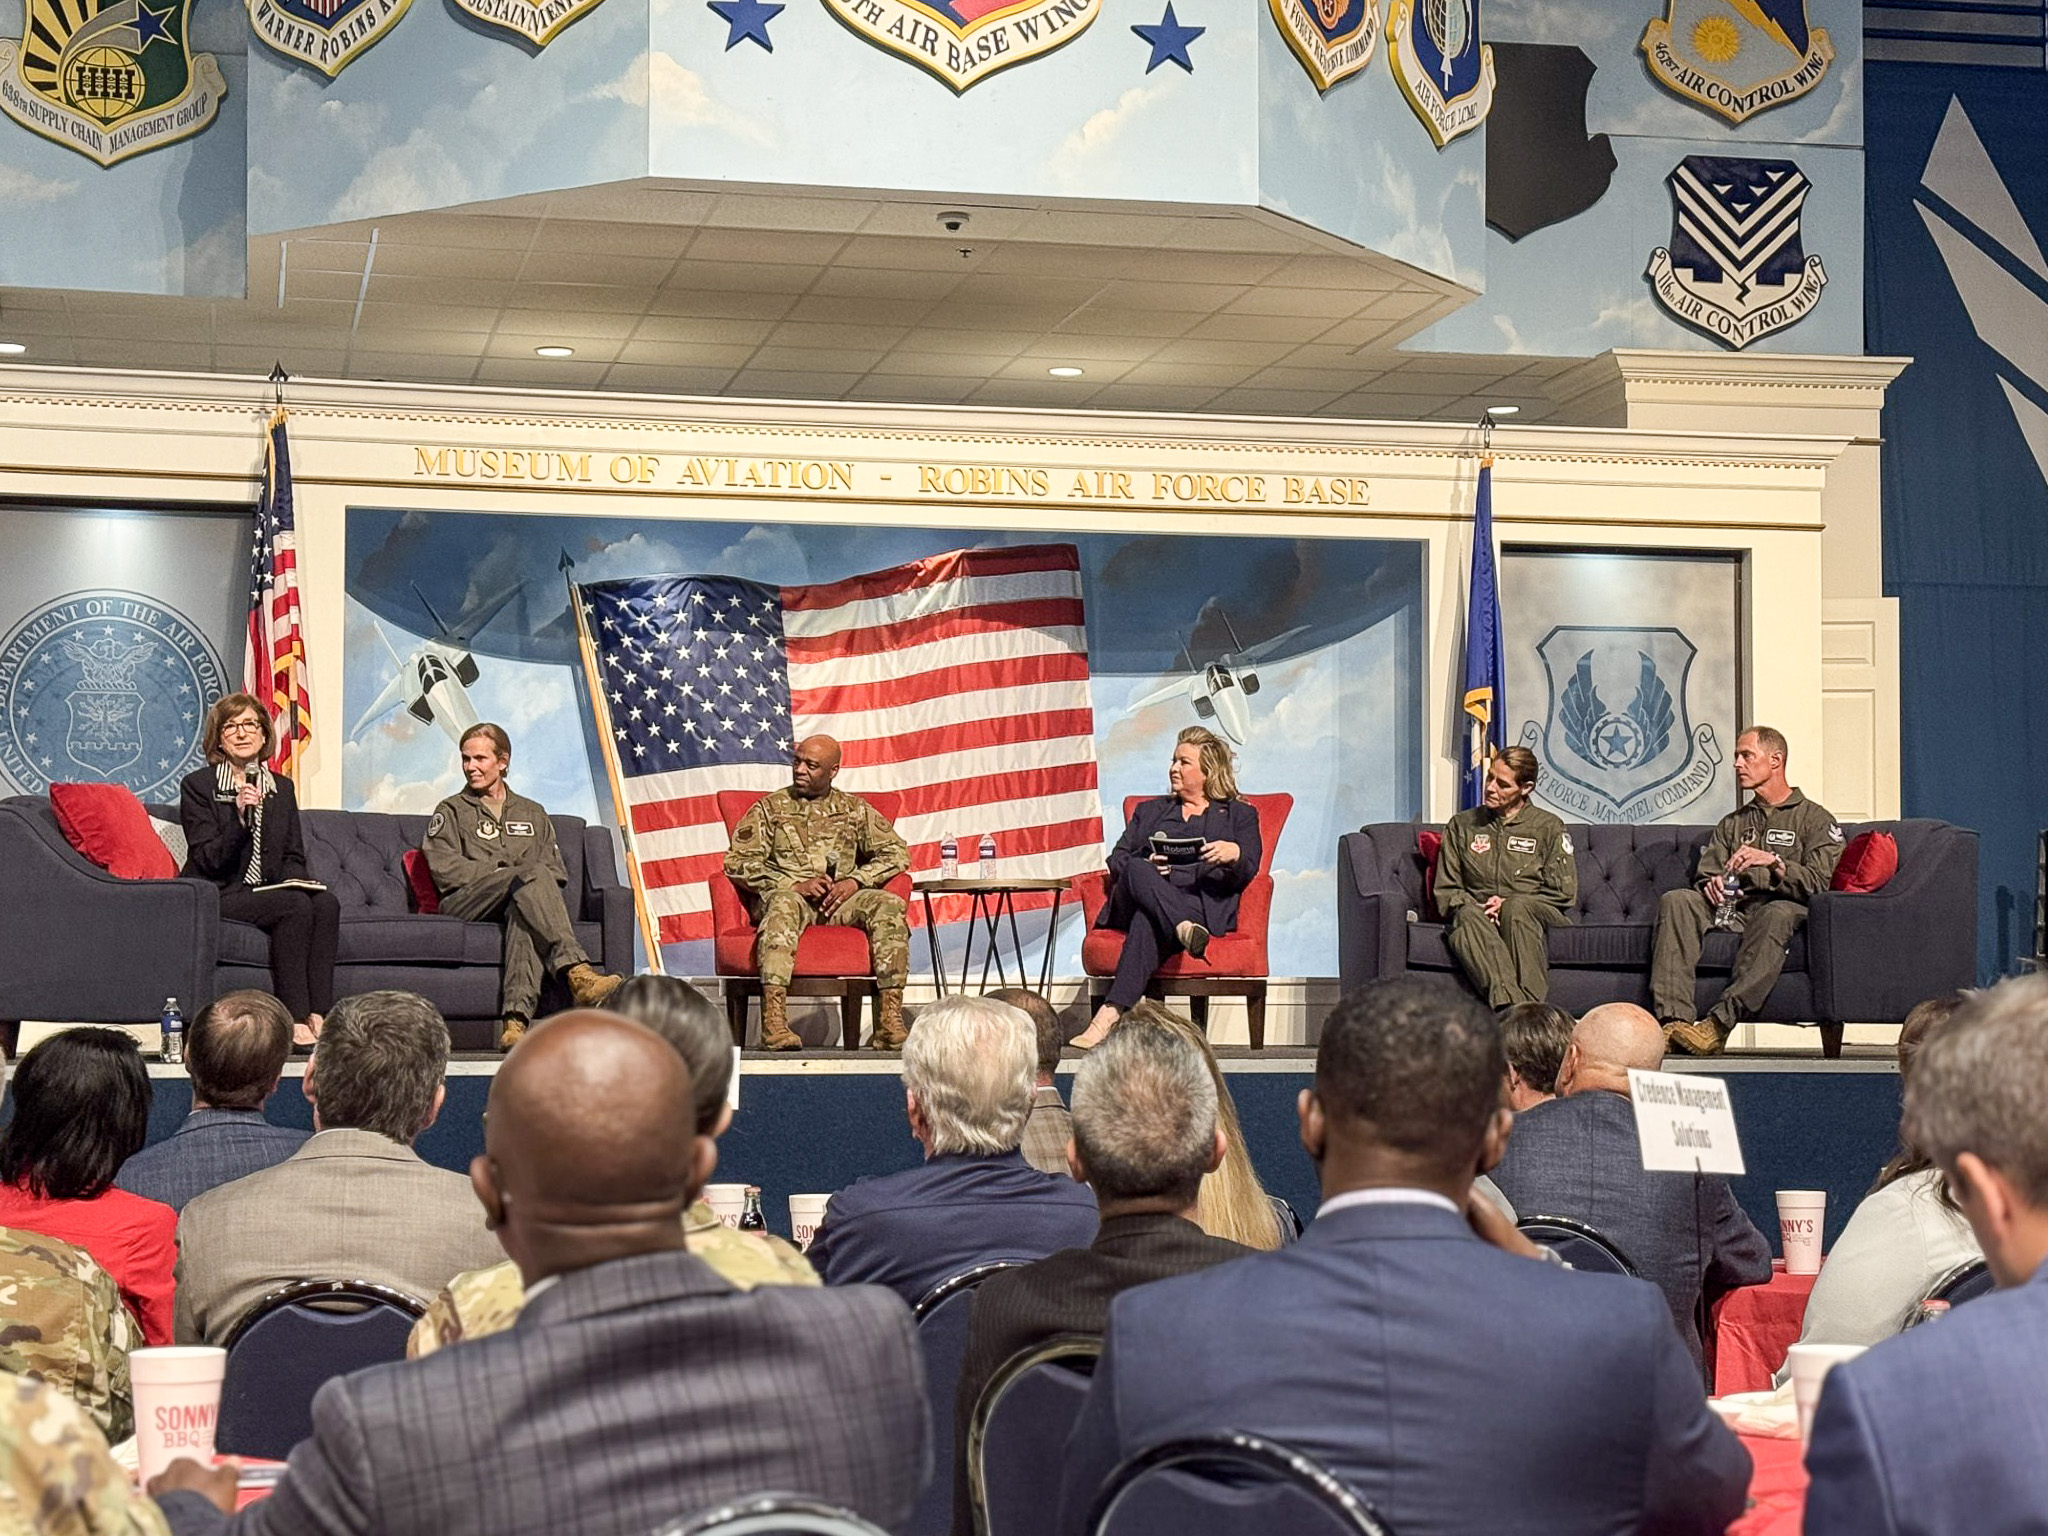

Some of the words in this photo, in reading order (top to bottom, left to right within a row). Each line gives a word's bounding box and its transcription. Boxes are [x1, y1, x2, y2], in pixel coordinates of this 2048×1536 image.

[257, 1, 314, 55] WARNER
[320, 7, 376, 64] ROBINS
[887, 14, 939, 56] AIR
[946, 26, 1010, 74] BASE
[1675, 67, 1706, 94] AIR
[1706, 79, 1795, 113] CONTROL
[1793, 51, 1824, 87] WING
[28, 101, 69, 133] SUPPLY
[70, 122, 103, 153] CHAIN
[109, 113, 175, 154] MANAGEMENT
[176, 92, 208, 127] GROUP
[1674, 294, 1704, 320] AIR
[1706, 304, 1793, 342] CONTROL
[1790, 274, 1819, 311] WING
[413, 446, 593, 483] MUSEUM
[609, 454, 661, 484] OF
[677, 457, 855, 491] AVIATION
[918, 464, 1050, 497] ROBINS
[1067, 470, 1135, 500] AIR
[1152, 473, 1267, 503] FORCE
[1283, 477, 1370, 506] BASE
[86, 600, 113, 616] OF
[119, 601, 162, 627] THE
[162, 621, 196, 652] AIR
[1546, 777, 1590, 812] FORCE
[1653, 760, 1711, 811] COMMAND
[1675, 1079, 1727, 1114] Management
[1671, 1119, 1712, 1149] Solutions
[162, 1430, 201, 1448] BBQ
